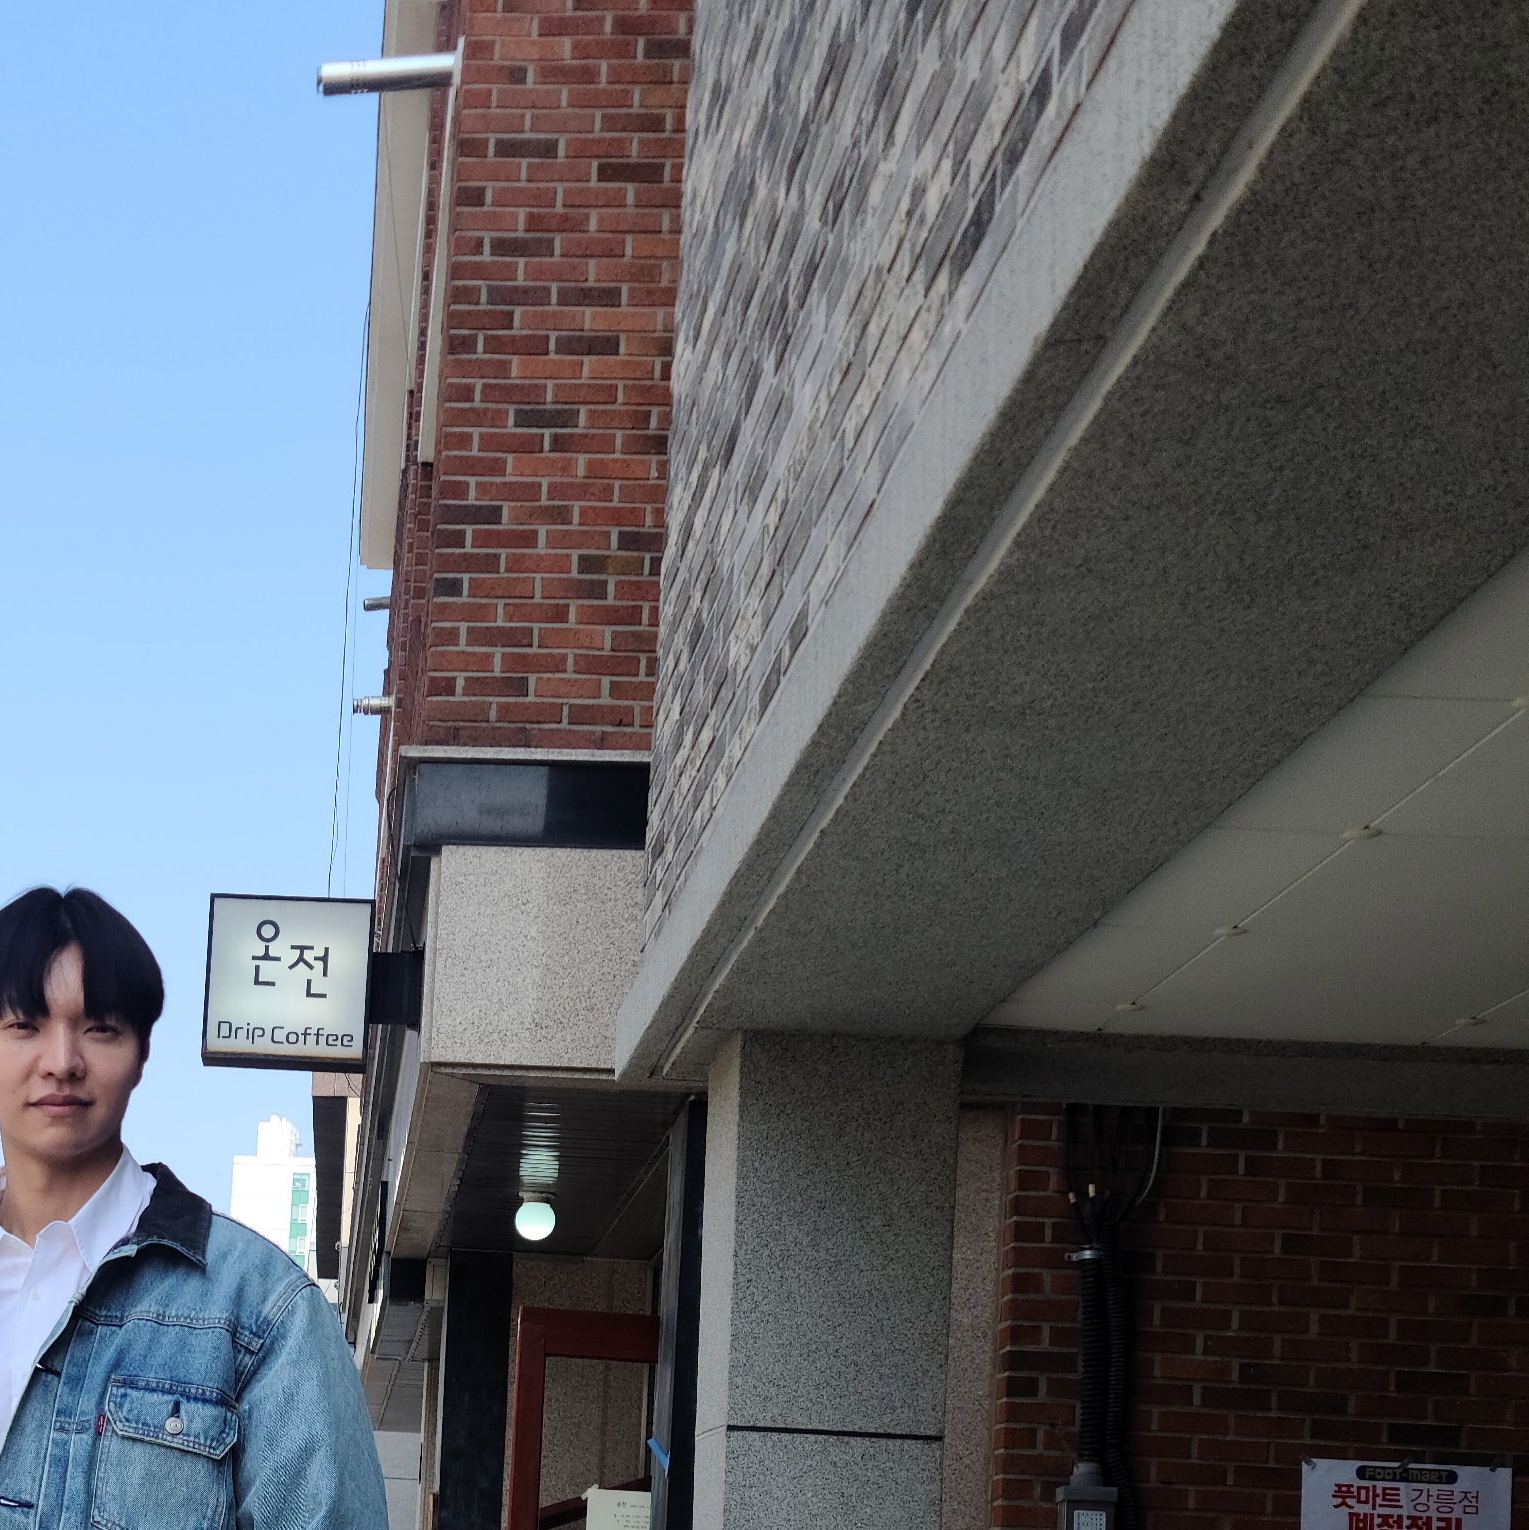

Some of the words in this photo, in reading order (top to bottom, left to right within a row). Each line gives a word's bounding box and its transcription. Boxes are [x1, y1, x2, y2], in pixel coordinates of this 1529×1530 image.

[251, 919, 330, 999] 온전
[216, 1020, 265, 1045] Drip
[270, 1026, 354, 1048] Coffee
[1331, 1483, 1404, 1510] 풋마트
[1409, 1488, 1480, 1515] 강릉점
